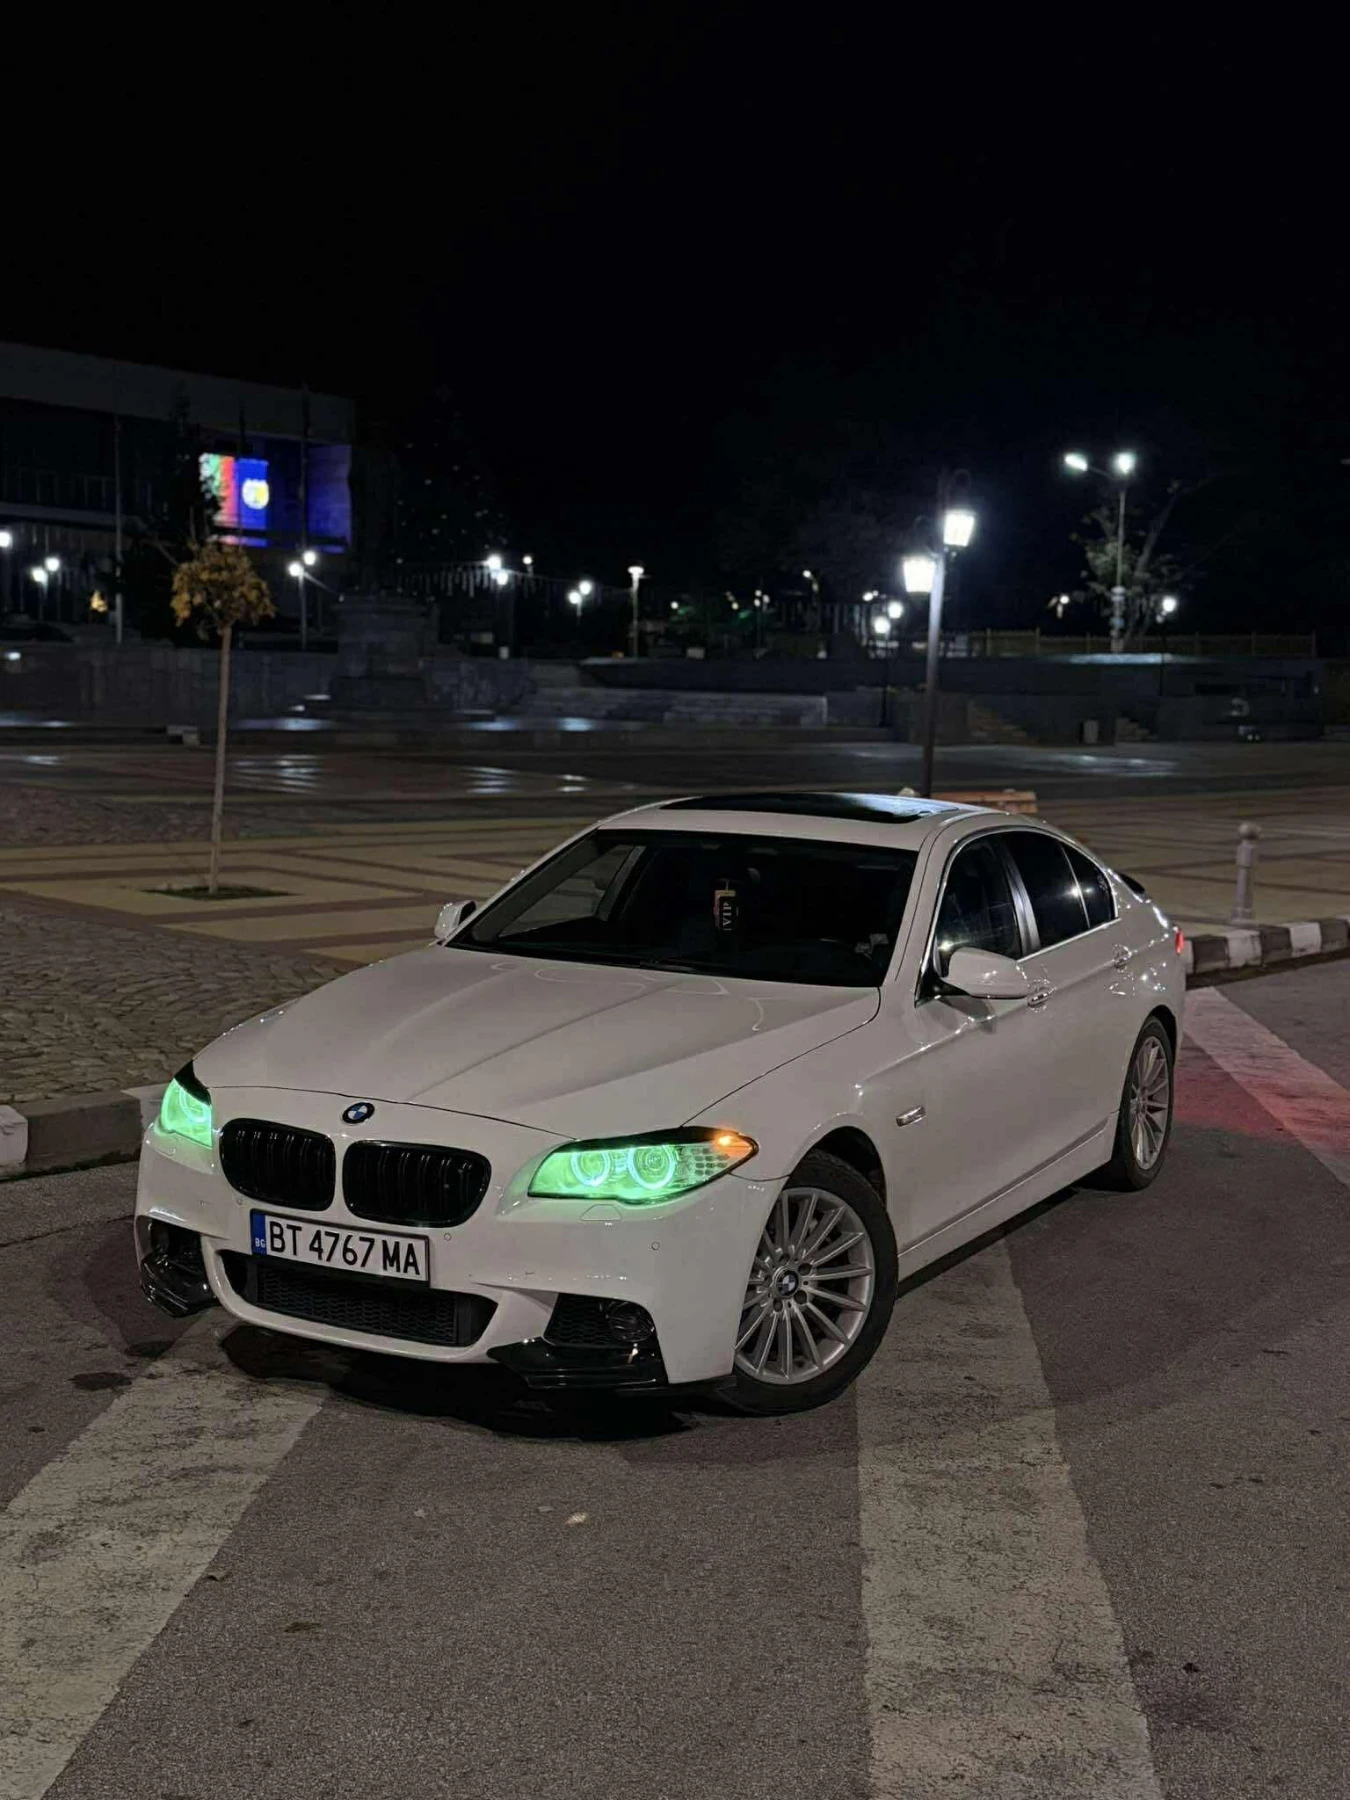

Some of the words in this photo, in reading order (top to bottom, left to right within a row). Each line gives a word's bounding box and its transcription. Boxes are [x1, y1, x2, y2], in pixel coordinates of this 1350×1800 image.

[722, 902, 732, 926] VIP
[254, 1238, 266, 1249] BG
[269, 1221, 302, 1256] BT
[309, 1229, 375, 1267] 4767
[382, 1239, 420, 1275] MA
